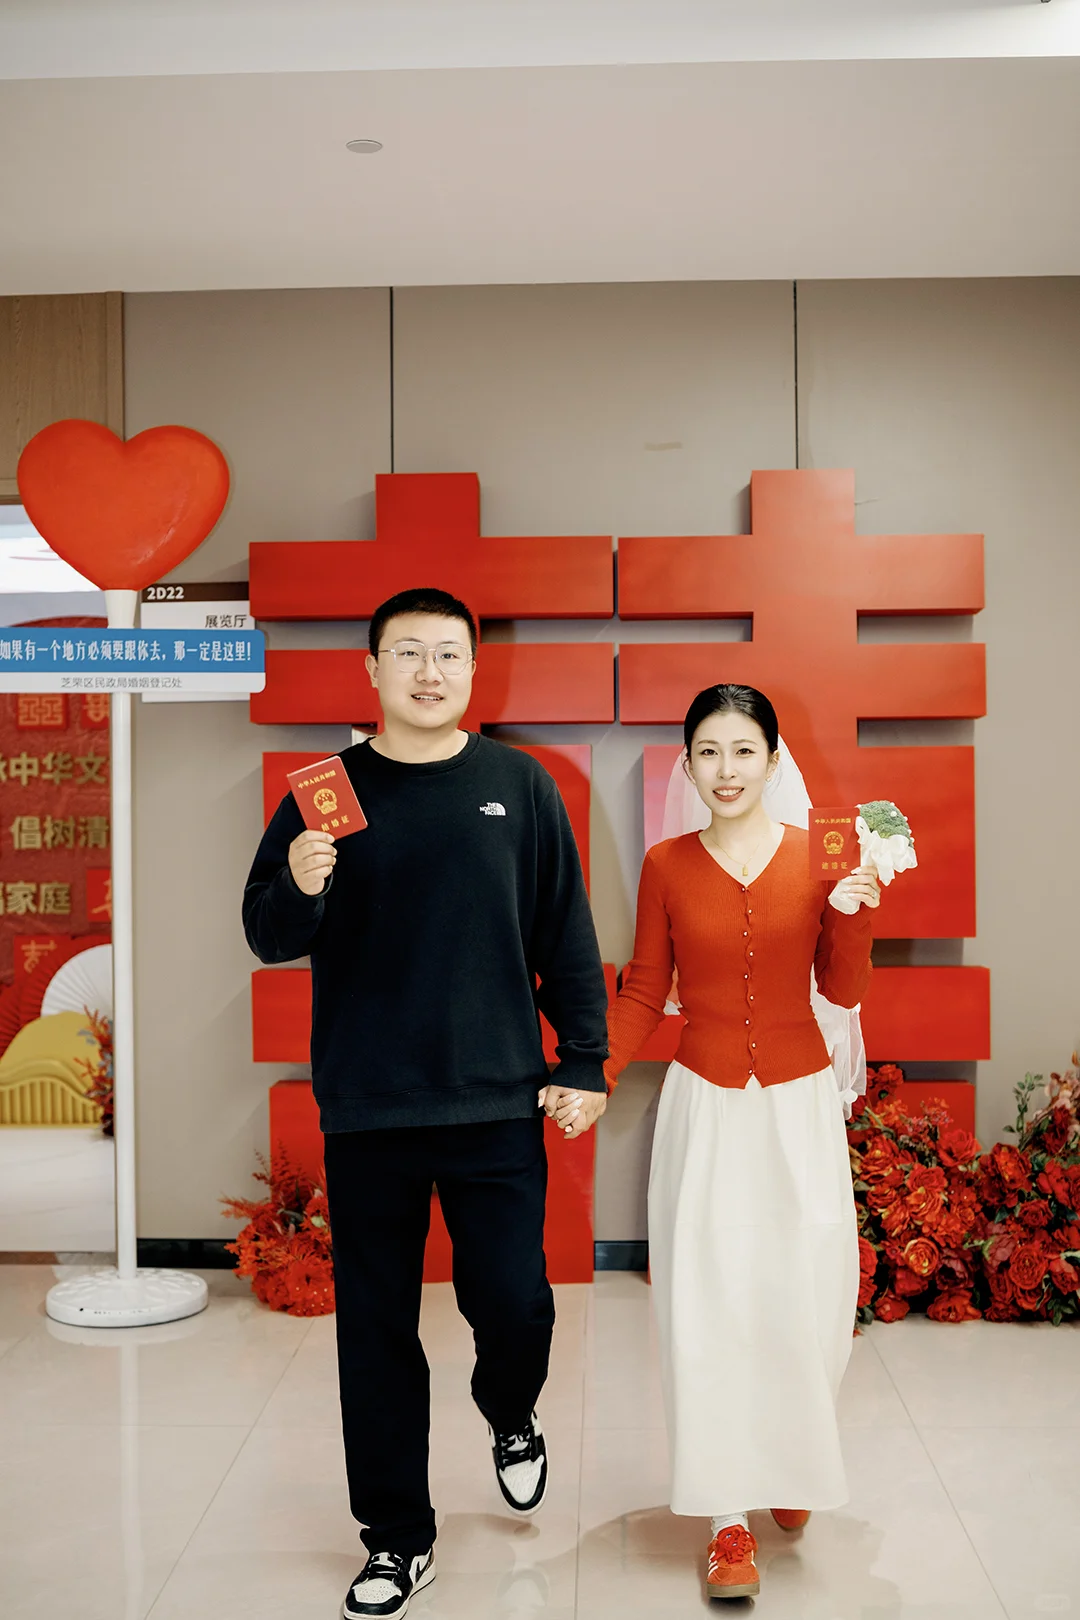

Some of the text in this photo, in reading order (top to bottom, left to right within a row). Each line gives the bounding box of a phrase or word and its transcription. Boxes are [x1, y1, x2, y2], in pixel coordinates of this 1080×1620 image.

[147, 586, 184, 600] 2D22
[205, 615, 247, 628] 展览厅
[0, 881, 71, 915] 家庭
